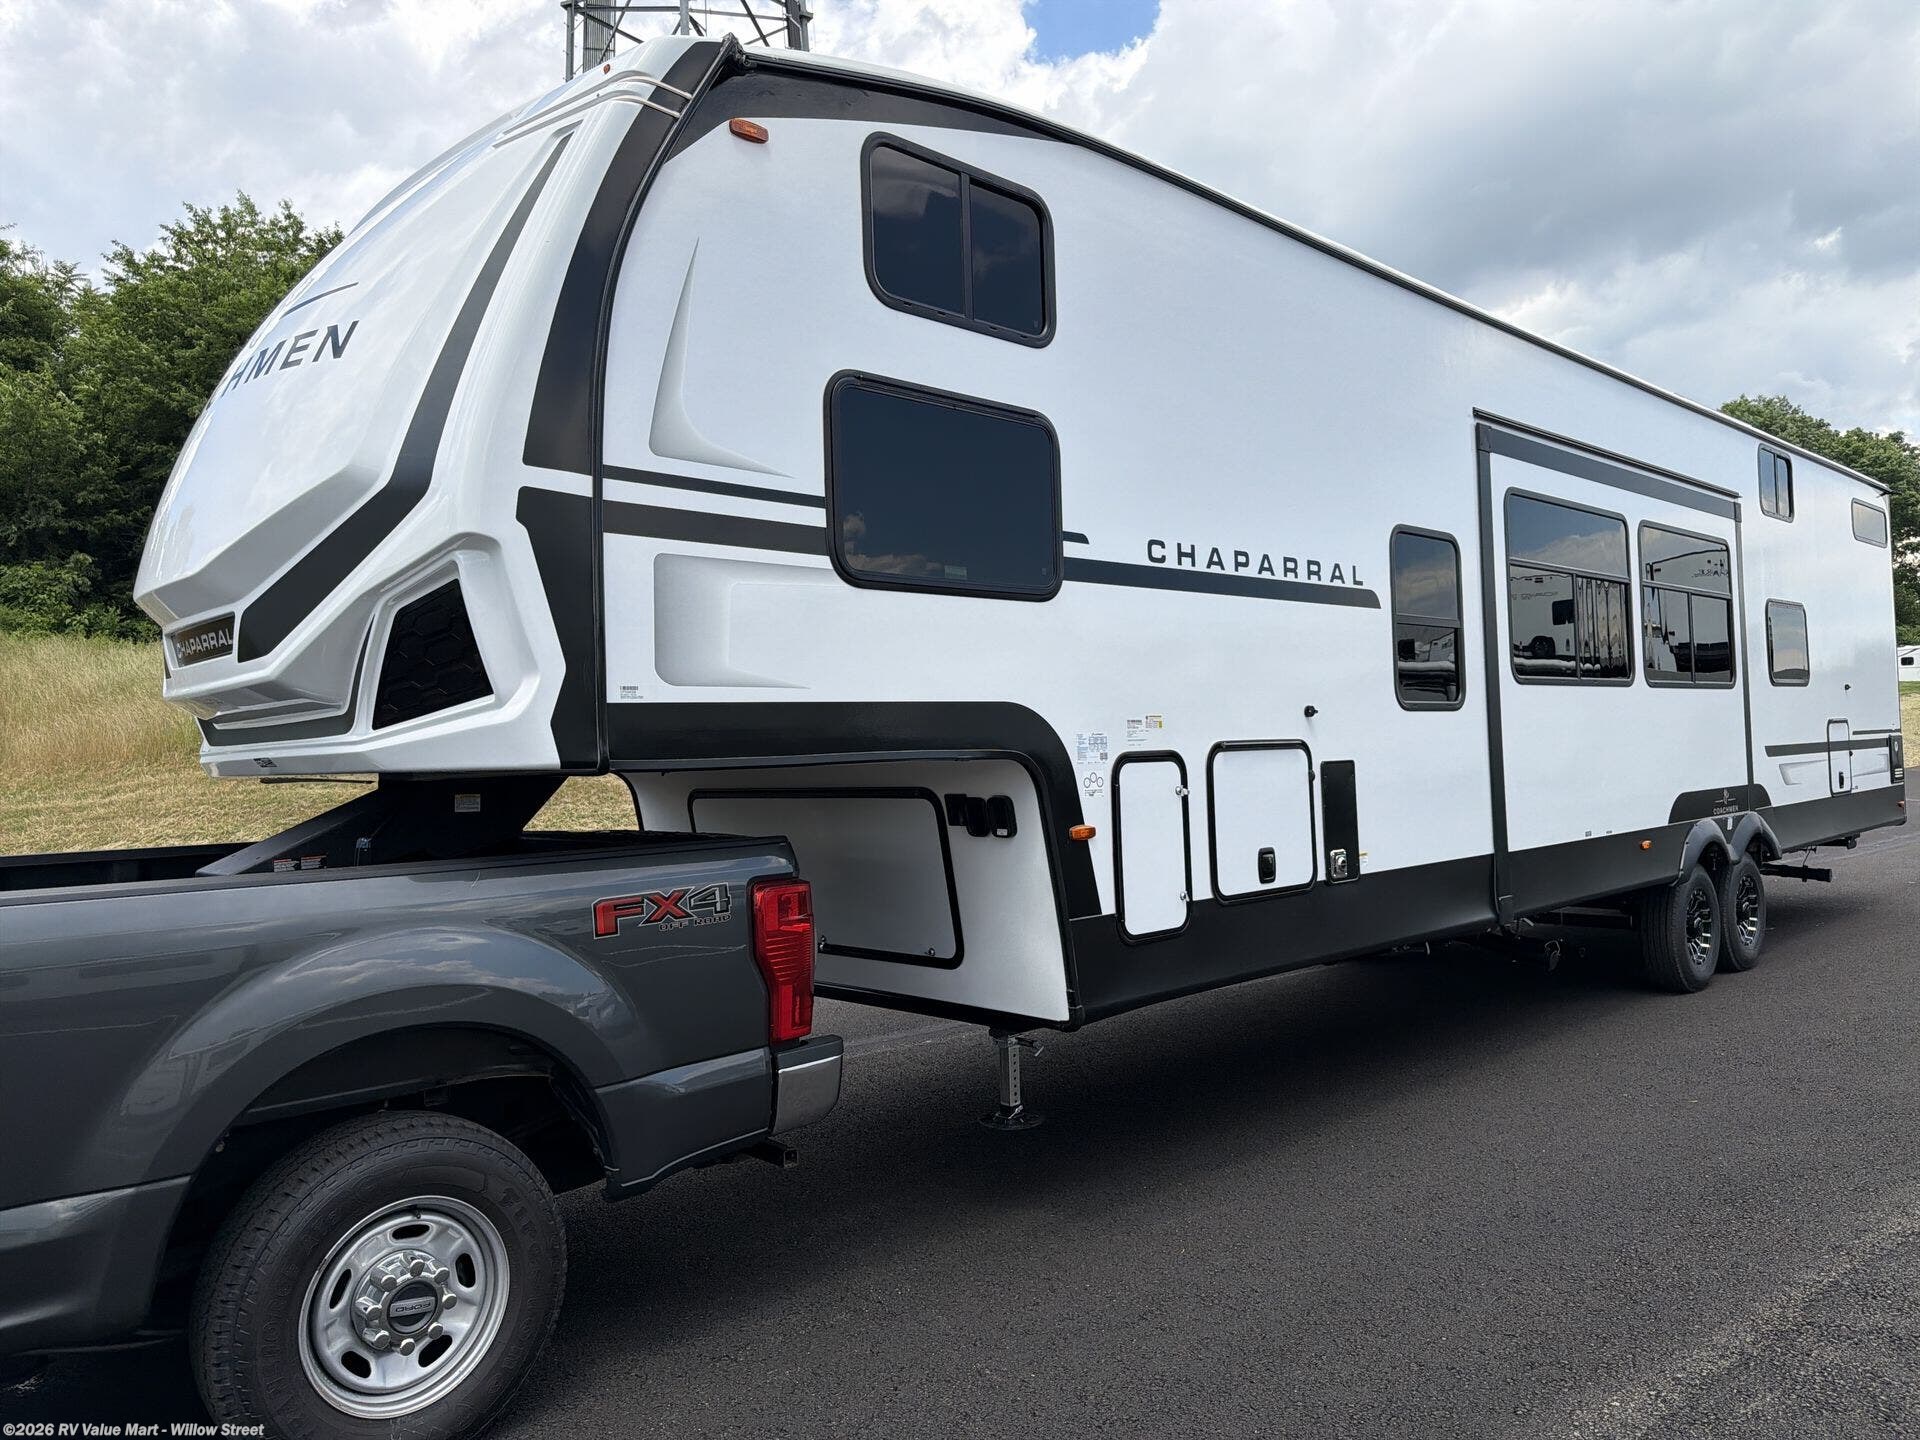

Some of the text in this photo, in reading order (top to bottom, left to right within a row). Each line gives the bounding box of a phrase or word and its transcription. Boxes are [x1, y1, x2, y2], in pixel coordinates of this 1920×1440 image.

[208, 320, 360, 404] HMEN
[1147, 538, 1364, 586] CHAPARRAL
[176, 628, 233, 659] CHAPARRAL
[591, 881, 732, 940] FX4
[658, 913, 732, 932] OFF ROAD
[395, 1301, 431, 1313] FORD
